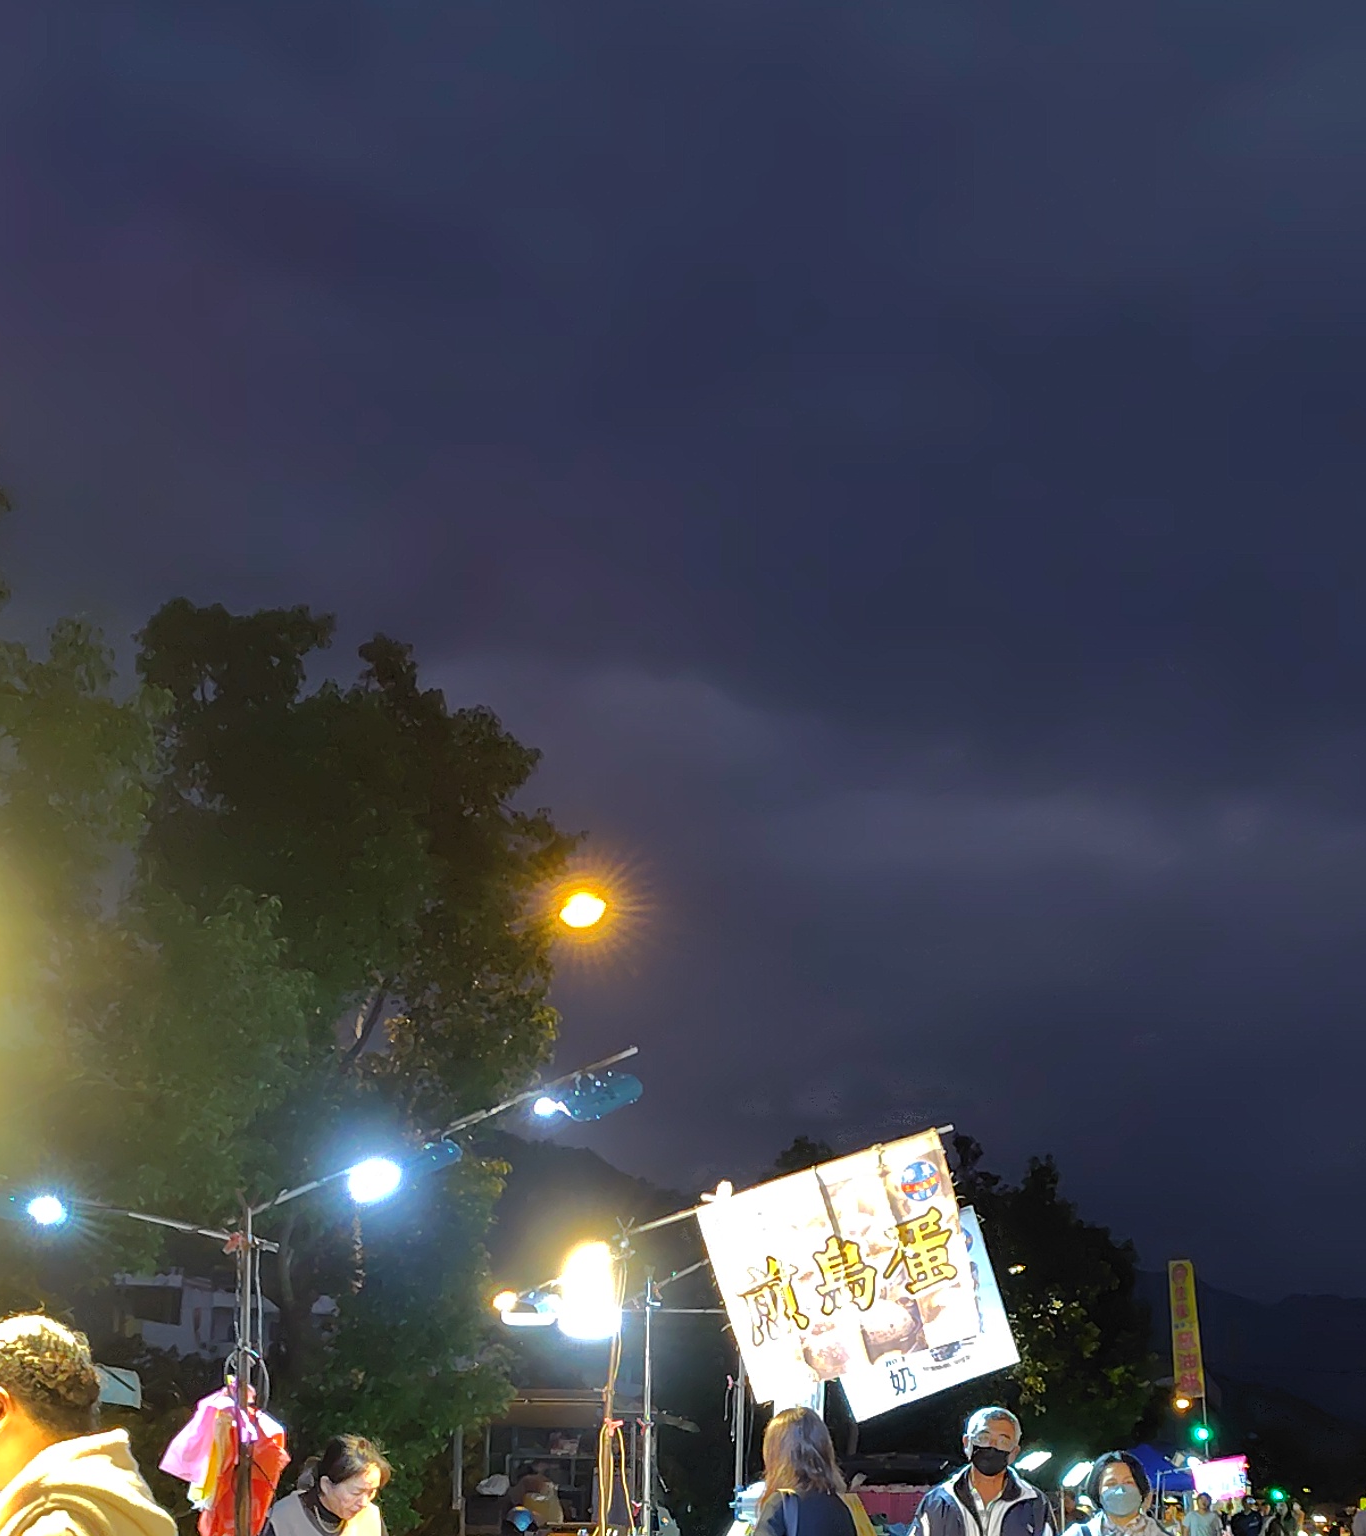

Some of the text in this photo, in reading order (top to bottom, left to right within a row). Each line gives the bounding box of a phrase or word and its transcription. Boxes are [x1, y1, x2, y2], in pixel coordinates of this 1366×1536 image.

[736, 1206, 959, 1348] 煎鳥蛋
[889, 1366, 917, 1396] 奶
